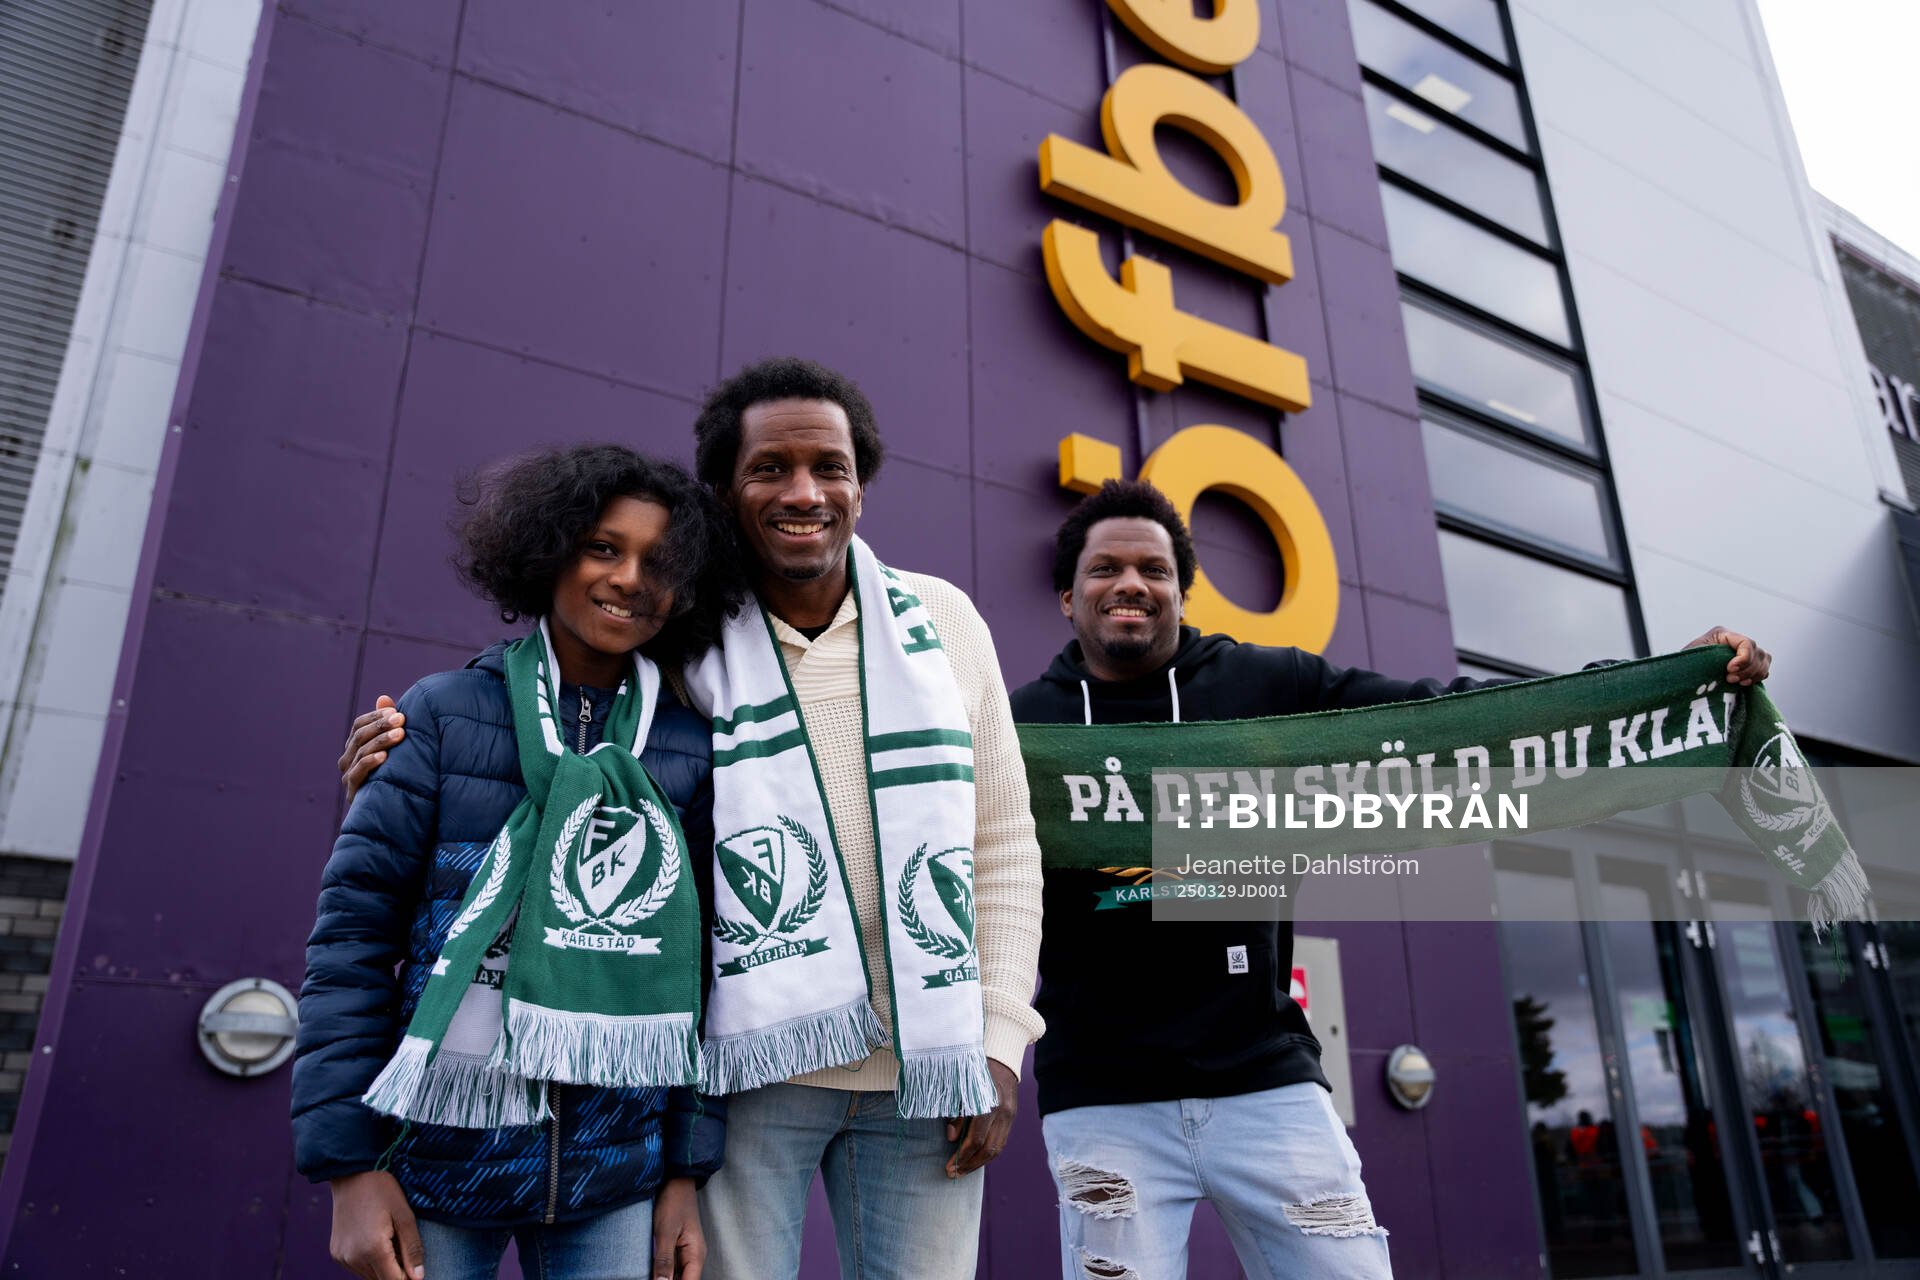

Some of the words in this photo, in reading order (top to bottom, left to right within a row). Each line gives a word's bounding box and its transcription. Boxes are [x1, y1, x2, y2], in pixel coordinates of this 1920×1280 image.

[1063, 756, 1144, 822] PÅ
[1509, 725, 1592, 789] DU
[583, 818, 616, 860] F
[591, 844, 626, 889] BK
[561, 931, 636, 948] KARLSTAD
